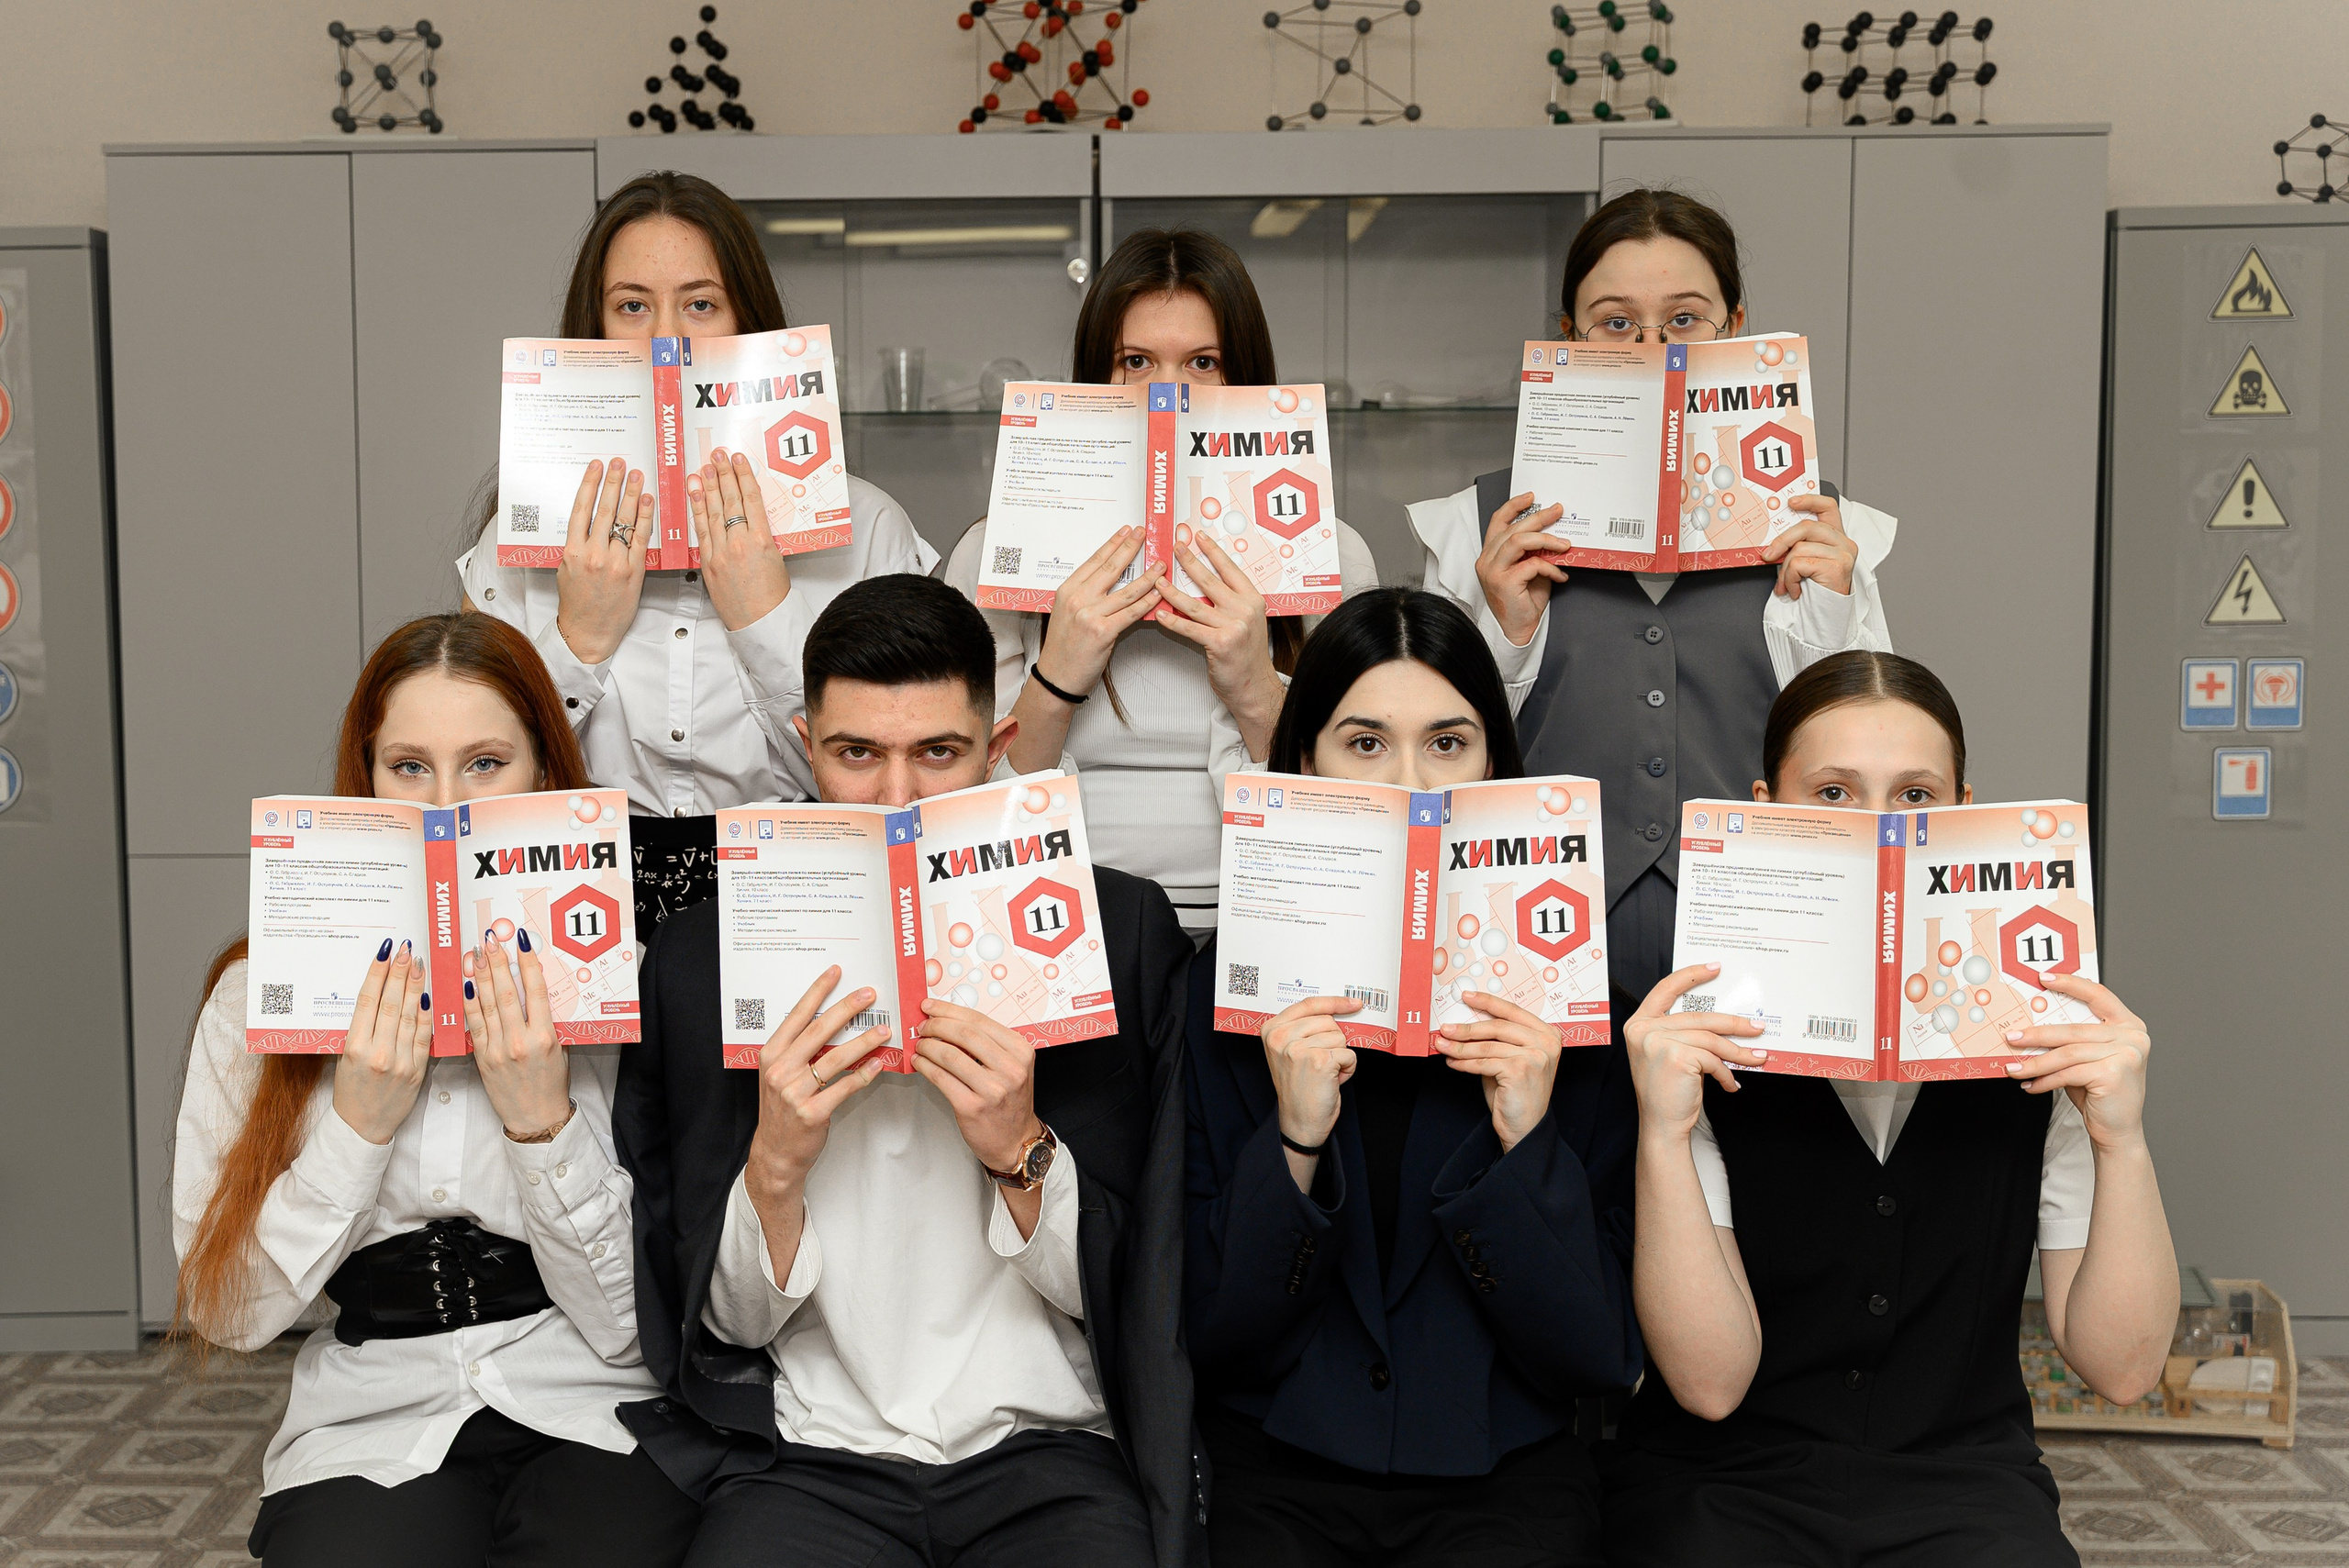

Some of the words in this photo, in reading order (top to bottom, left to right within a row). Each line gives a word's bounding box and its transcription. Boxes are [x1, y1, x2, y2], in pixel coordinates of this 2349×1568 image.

[695, 370, 824, 408] ХИМИЯ
[1686, 382, 1799, 413] ХИМИЯ
[663, 403, 677, 466] ХИМИЯ
[783, 433, 814, 458] 11
[1189, 430, 1314, 456] ХИМИЯ
[1666, 409, 1679, 472] ХИМИЯ
[1758, 446, 1788, 469] 11
[1154, 450, 1167, 513] ХИМИЯ
[1272, 493, 1302, 516] 11
[667, 528, 681, 540] 11
[1661, 534, 1673, 546] 11
[474, 842, 617, 879] ХИМИЯ
[927, 829, 1073, 883] ХИМИЯ
[1449, 835, 1587, 871] ХИМИЯ
[1926, 860, 2074, 895] ХИМИЯ
[436, 881, 451, 947] ХИМИЯ
[1030, 903, 1065, 933] 11
[1412, 869, 1430, 940] ХИМИЯ
[571, 911, 602, 936] 11
[899, 885, 916, 957] ХИМИЯ
[1537, 907, 1570, 934] 11
[1883, 890, 1896, 963] ХИМИЯ
[2022, 935, 2059, 962] 11
[441, 1014, 457, 1025] 11
[1406, 1011, 1422, 1024] 11
[1880, 1037, 1893, 1050] 11
